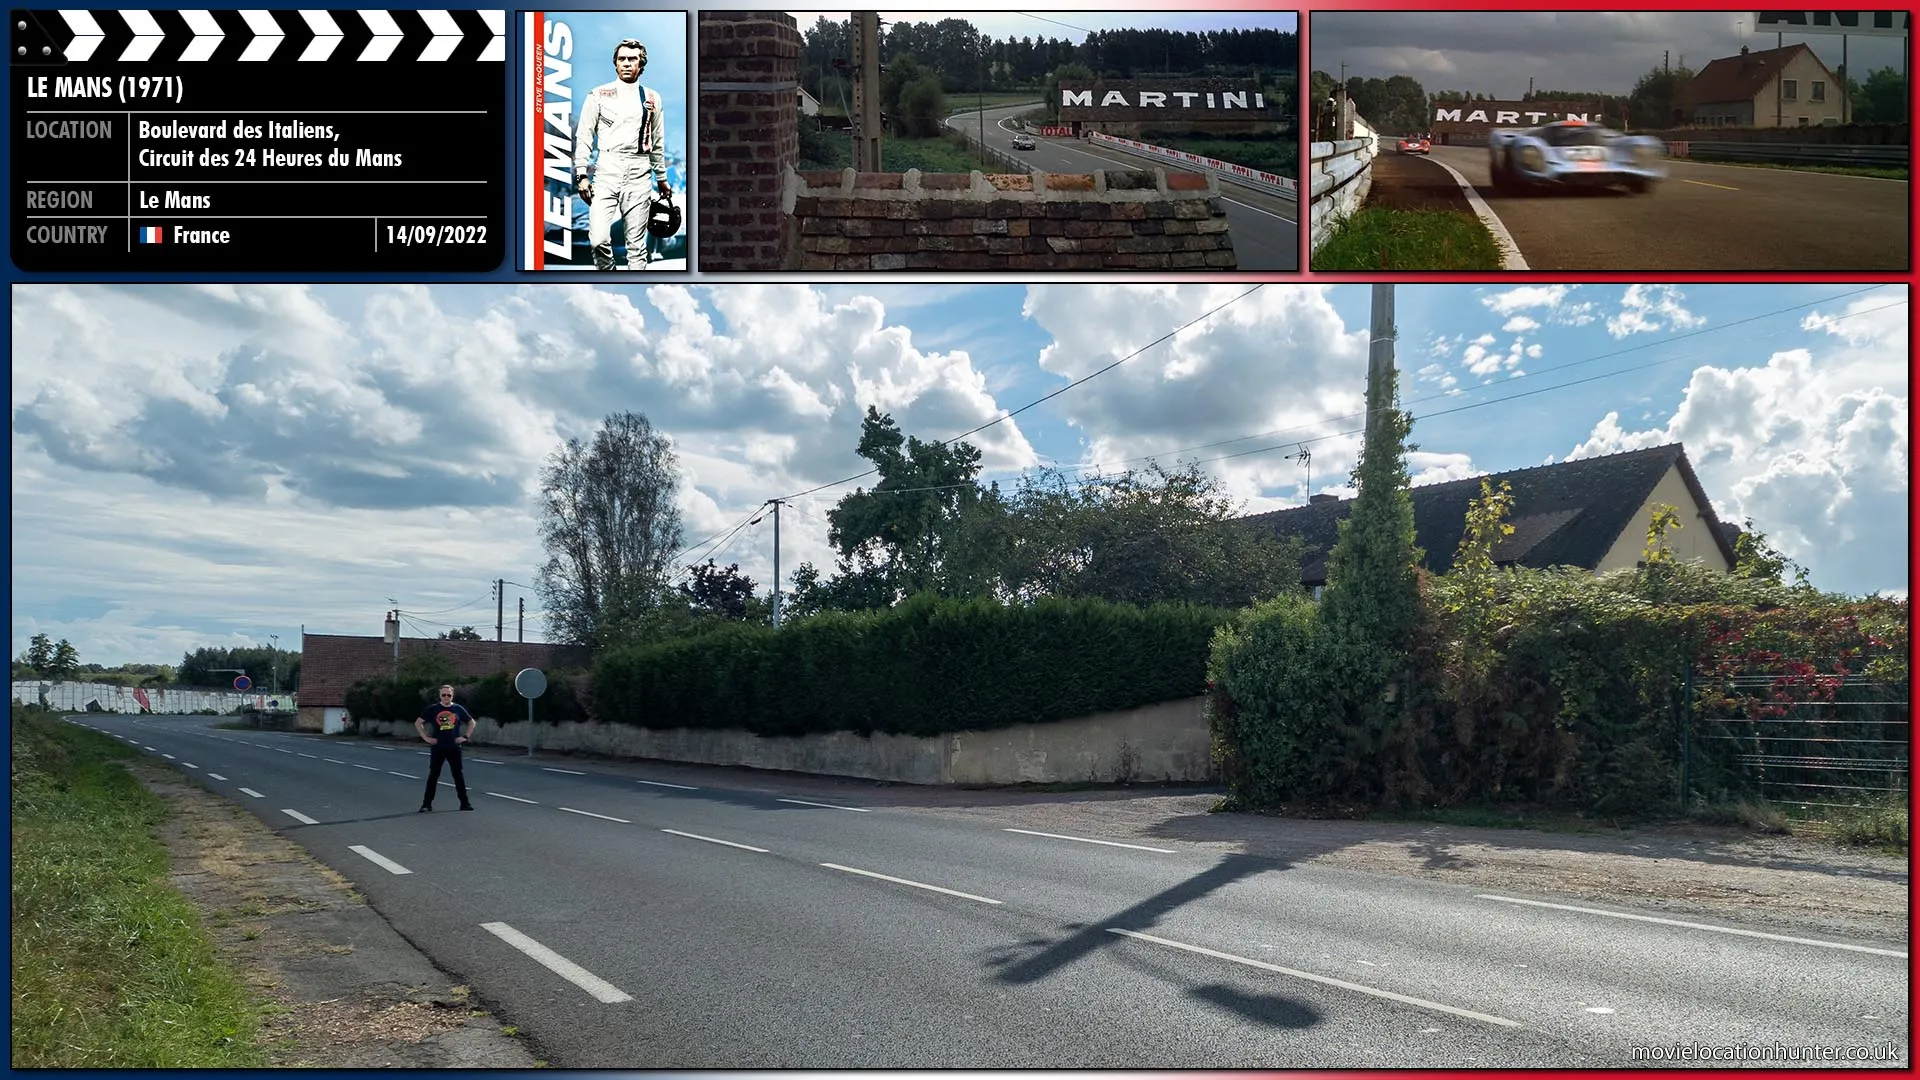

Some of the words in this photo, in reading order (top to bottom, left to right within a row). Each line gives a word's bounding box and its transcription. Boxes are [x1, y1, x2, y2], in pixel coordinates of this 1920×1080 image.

[543, 19, 574, 185] MANS
[1062, 89, 1265, 109] MARTINI
[543, 195, 573, 261] LE
